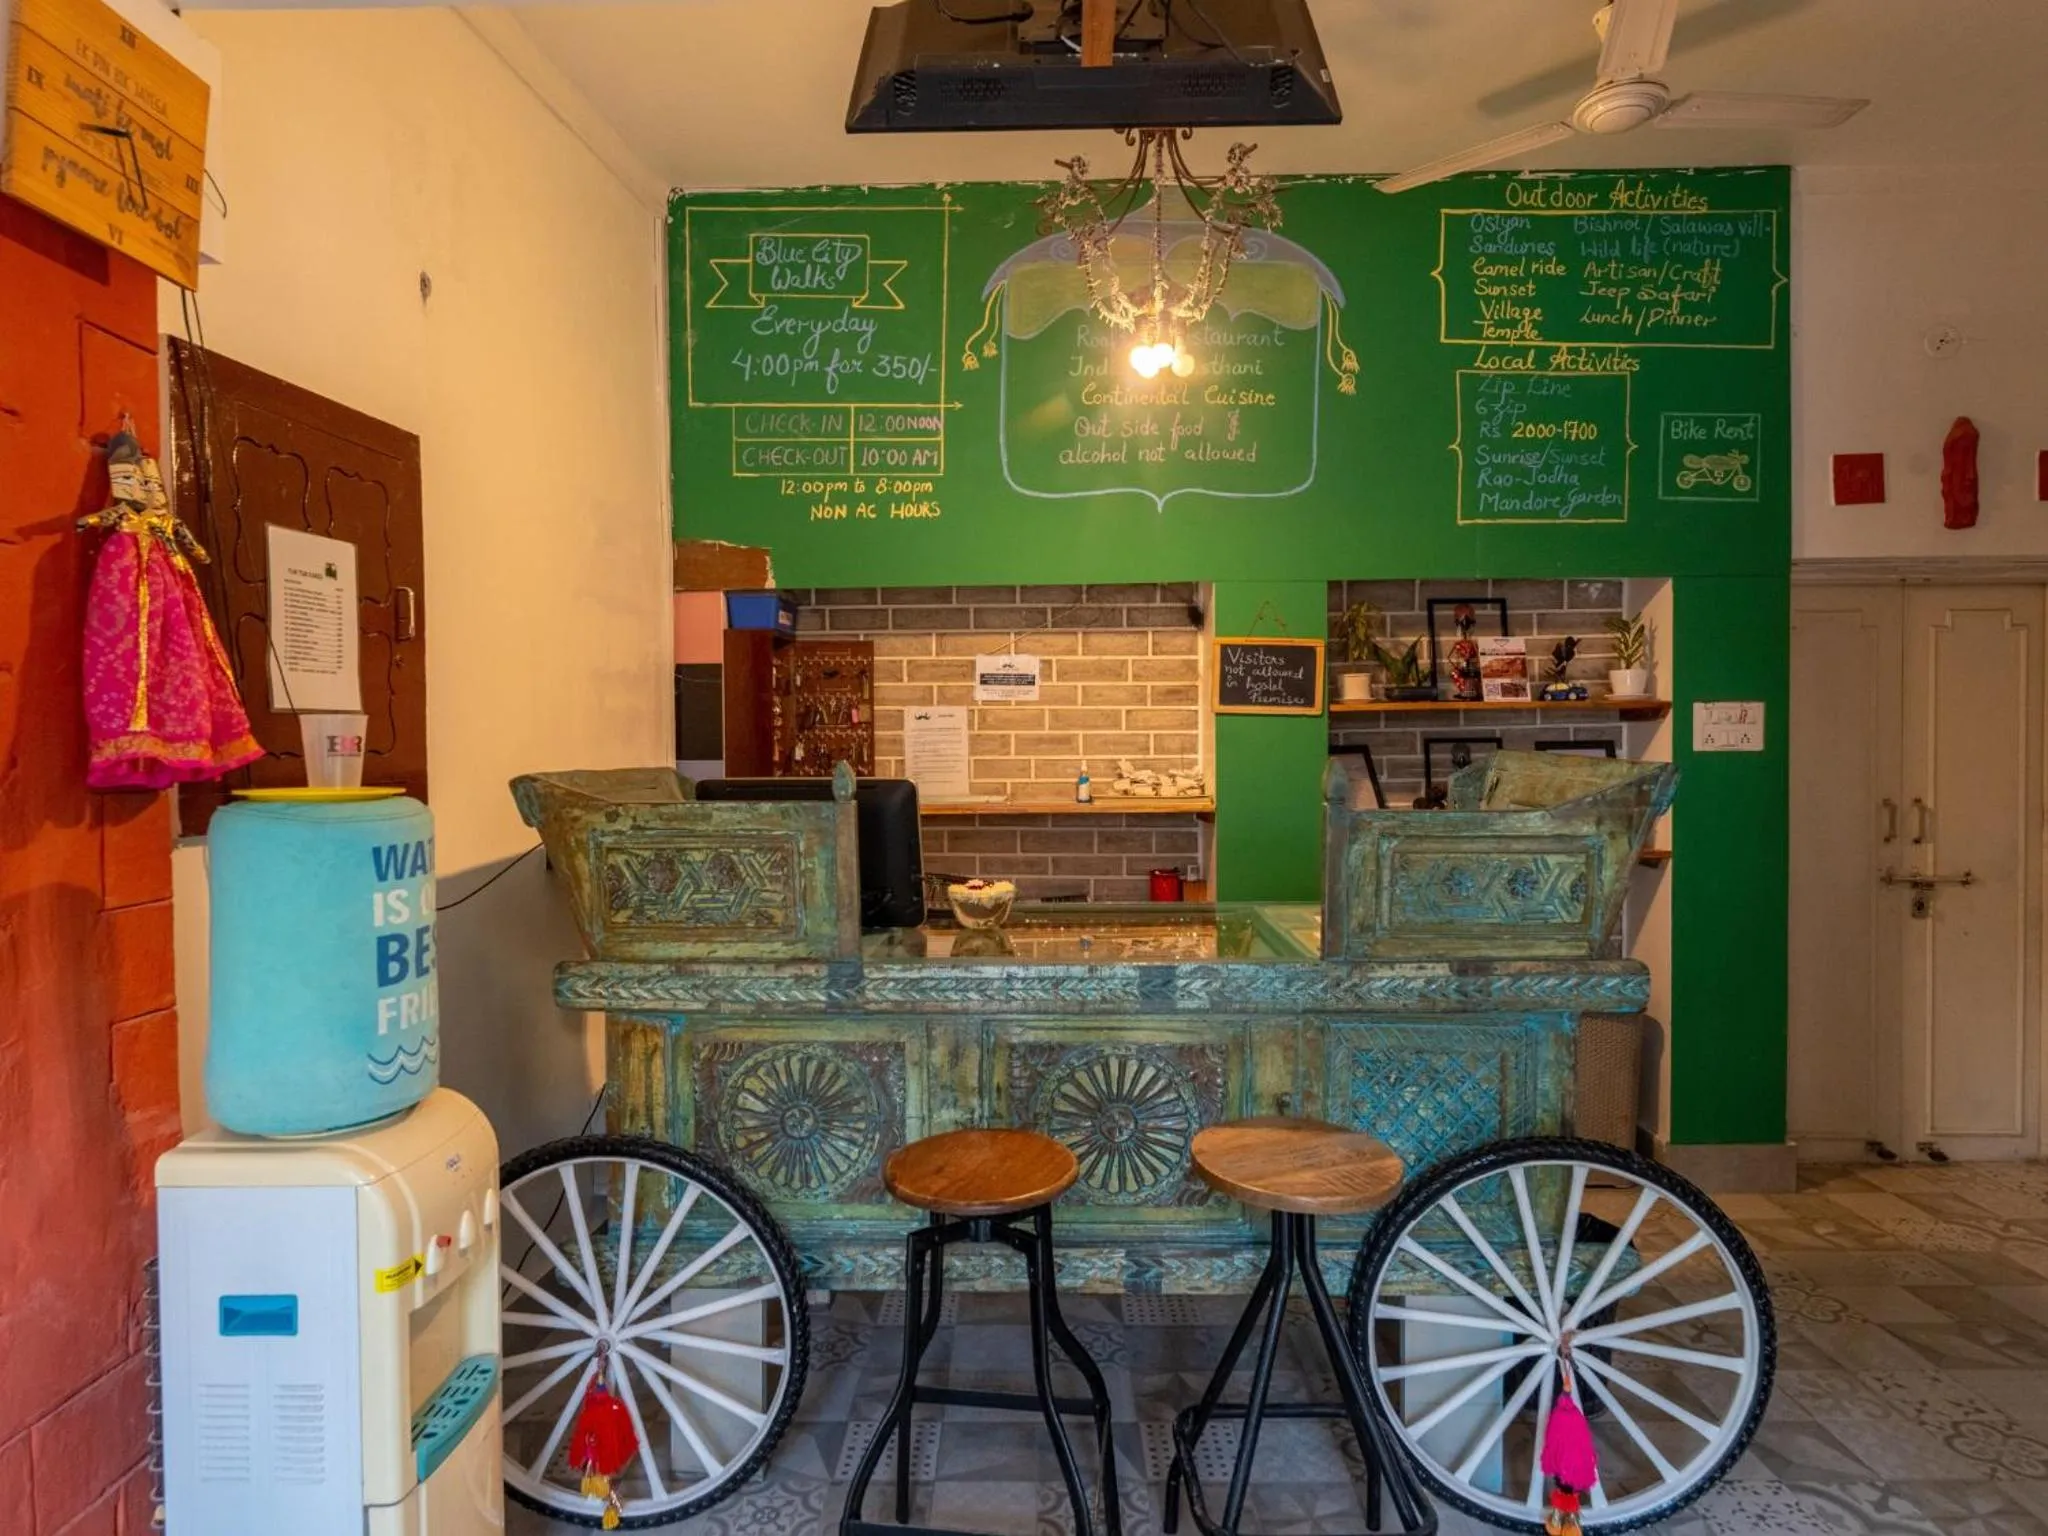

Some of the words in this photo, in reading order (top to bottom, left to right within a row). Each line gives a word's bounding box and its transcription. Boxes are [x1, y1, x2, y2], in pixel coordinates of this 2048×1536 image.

[27, 65, 45, 90] IX
[185, 173, 200, 196] III
[1609, 178, 1708, 212] Activities
[107, 222, 124, 246] VI
[756, 237, 806, 265] Blue
[812, 239, 863, 280] City
[1580, 239, 1621, 258] Wild
[771, 264, 836, 291] Walks
[1472, 256, 1525, 276] Camel
[1531, 256, 1567, 276] ride
[1474, 278, 1536, 297] Sunset
[1580, 281, 1631, 309] Jeep
[1636, 283, 1716, 314] Safari
[1480, 299, 1543, 334] Village
[1473, 320, 1543, 346] Temple
[1474, 344, 1537, 369] Local
[1549, 345, 1641, 372] Activities
[1082, 382, 1191, 405] Continental
[1204, 385, 1277, 406] Cuisine
[1528, 375, 1572, 398] Line
[1074, 413, 1112, 438] Out
[1120, 417, 1160, 438] side
[1169, 412, 1205, 449] food
[1670, 419, 1707, 441] Bike
[1715, 418, 1756, 440] Rent
[912, 446, 938, 467] AM
[1059, 443, 1127, 465] alcohol
[1138, 445, 1166, 463] not
[1185, 442, 1257, 463] allowed
[854, 478, 866, 494] to
[855, 502, 878, 519] AC
[890, 501, 941, 520] HOURS
[1226, 646, 1286, 666] Visitors
[1224, 664, 1245, 677] not
[1252, 666, 1304, 680] allowed
[373, 887, 410, 928] IS
